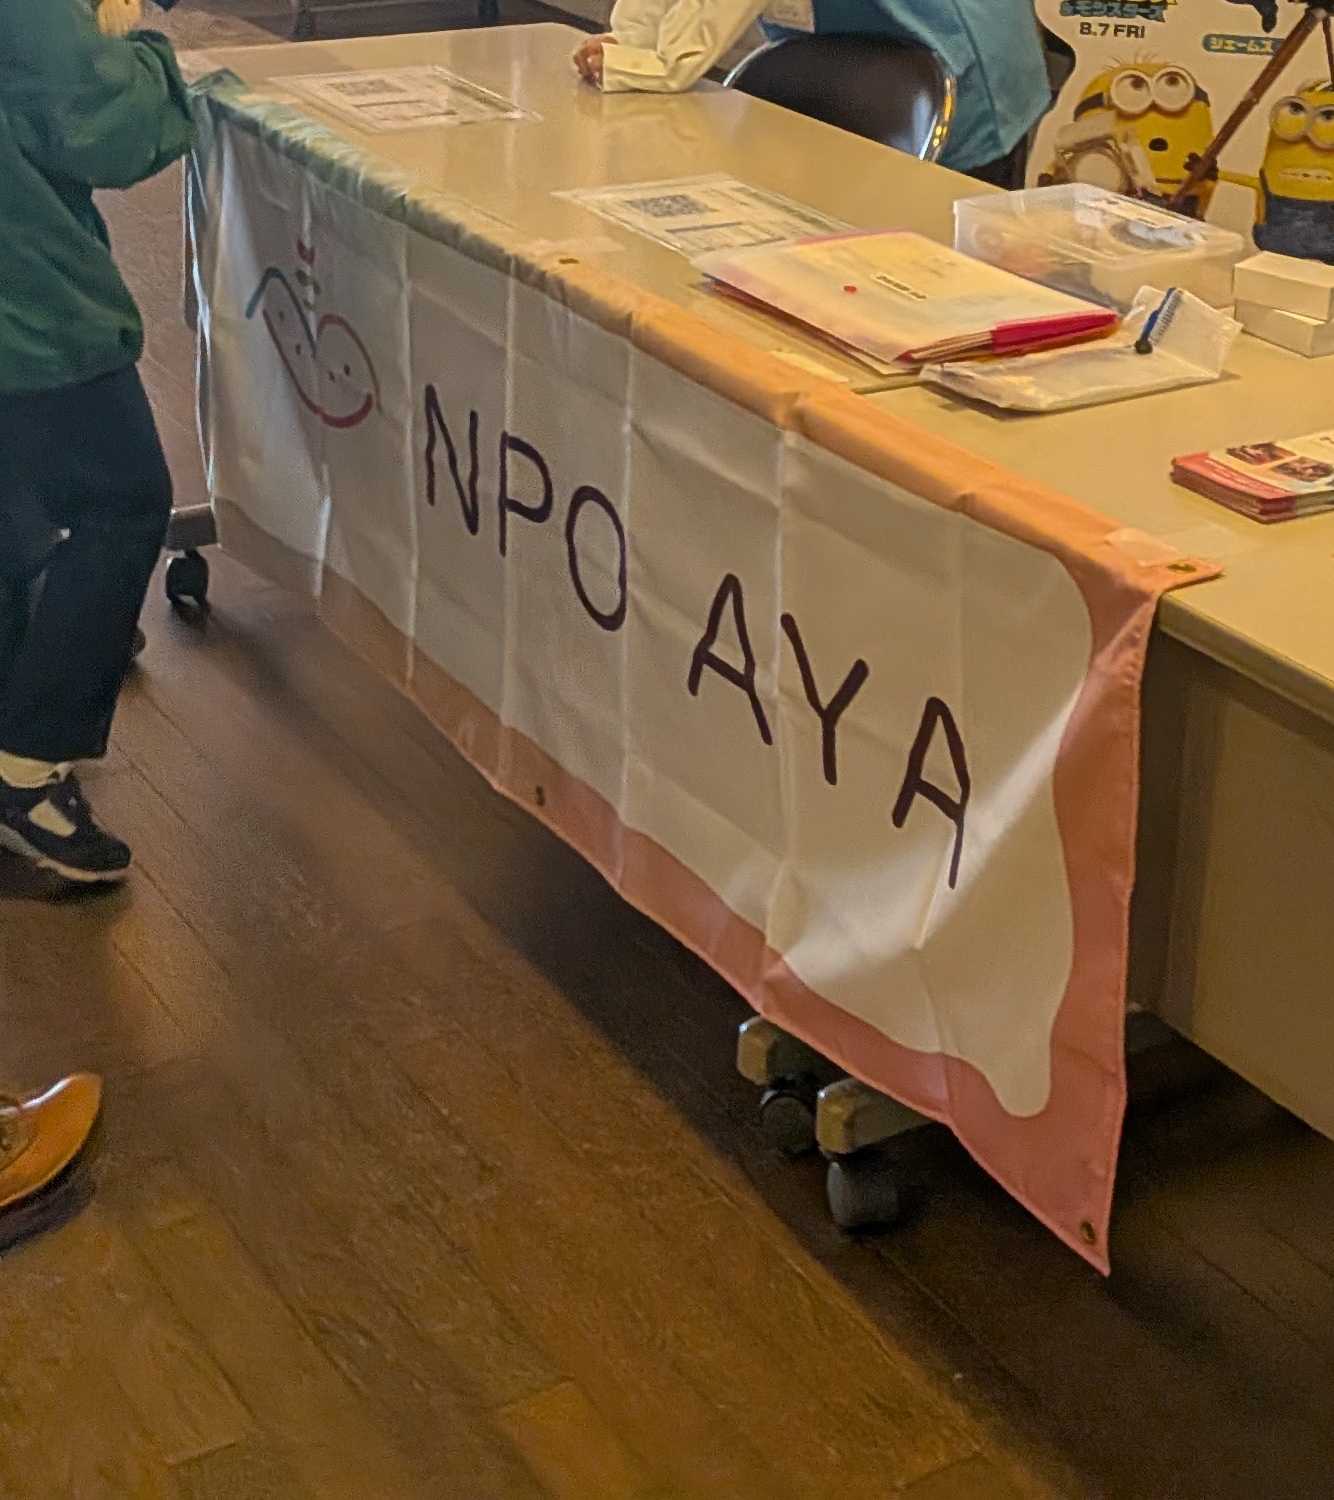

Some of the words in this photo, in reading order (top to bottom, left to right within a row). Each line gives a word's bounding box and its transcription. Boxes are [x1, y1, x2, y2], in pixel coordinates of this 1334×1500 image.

[1078, 21, 1110, 36] 8.7
[1113, 23, 1146, 39] FRI
[424, 383, 628, 632] NPO
[687, 572, 973, 891] AYA
